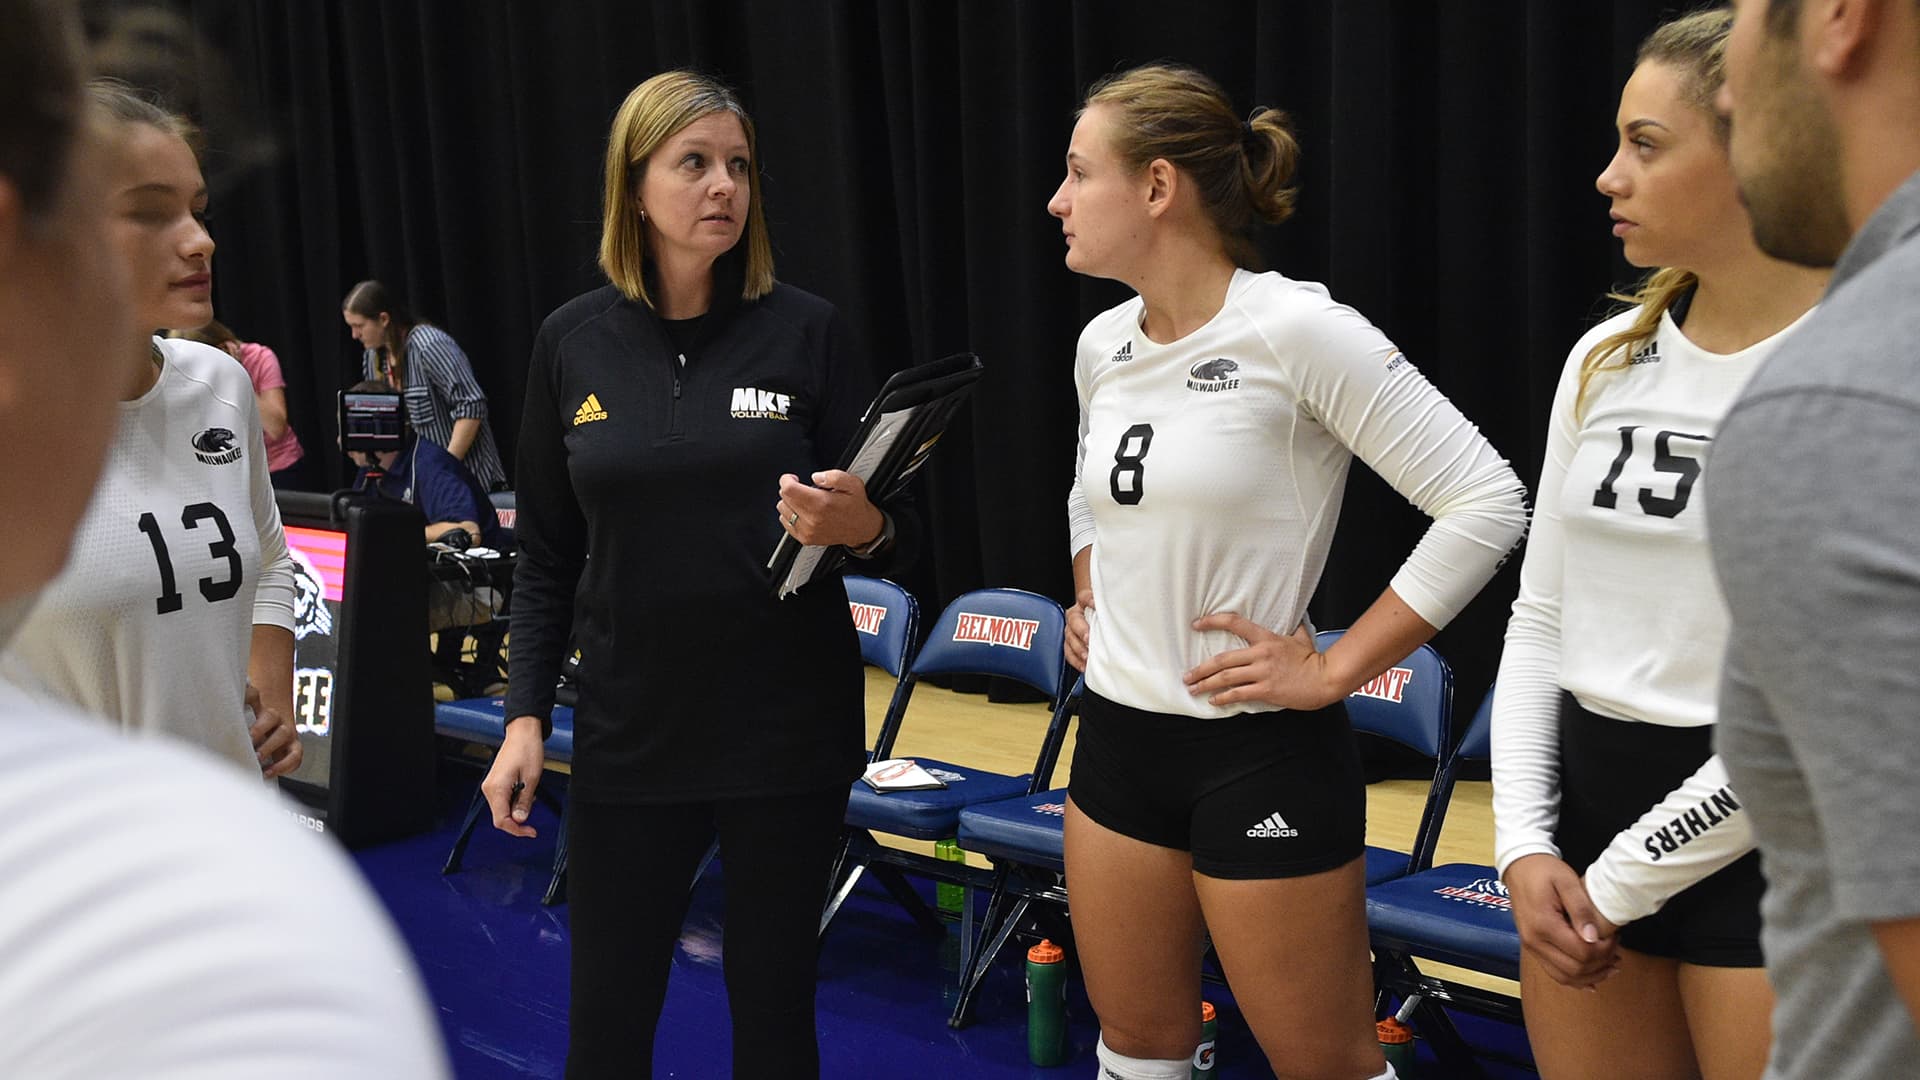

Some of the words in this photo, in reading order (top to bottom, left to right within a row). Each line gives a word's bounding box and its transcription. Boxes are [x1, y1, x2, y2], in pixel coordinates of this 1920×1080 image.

[1186, 378, 1240, 393] MILWAUKEE
[573, 410, 608, 426] adidas
[1110, 423, 1154, 505] 8
[1592, 425, 1713, 519] 15
[138, 501, 243, 615] 13
[954, 613, 1039, 649] BELMONT
[1356, 669, 1411, 701] ONT
[1246, 827, 1299, 838] adidas
[1644, 784, 1742, 862] NTHERS
